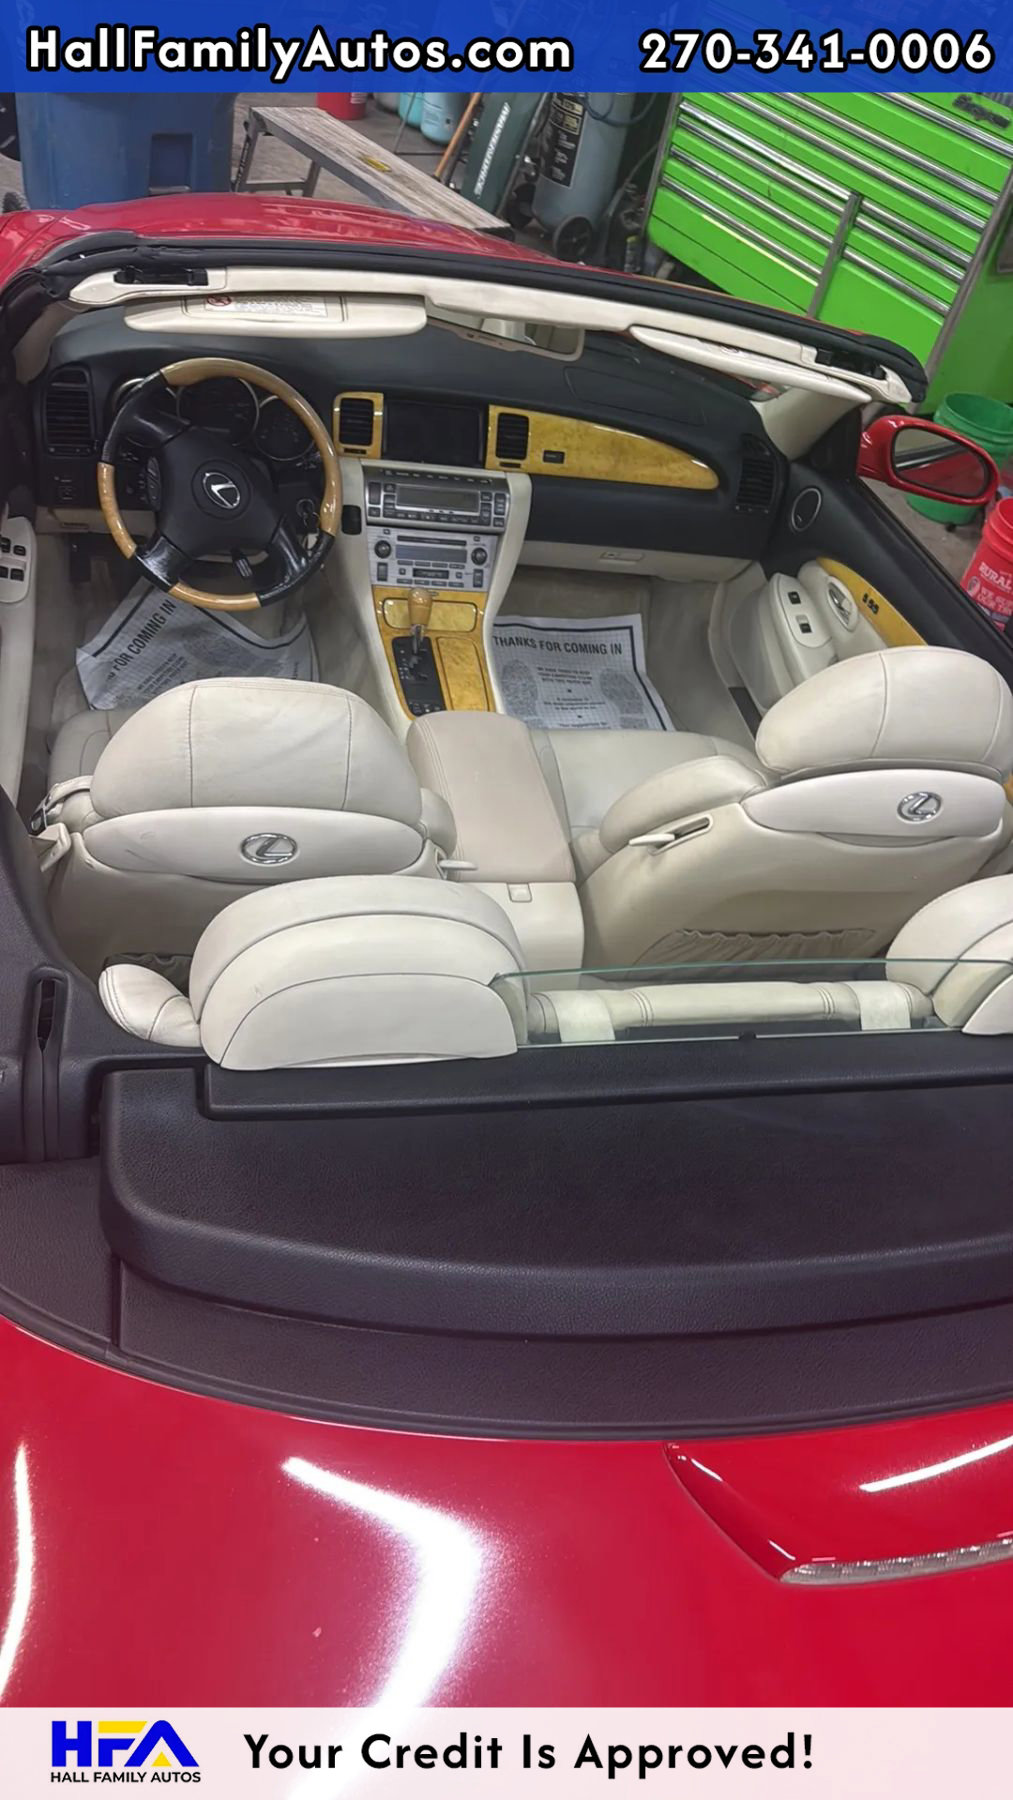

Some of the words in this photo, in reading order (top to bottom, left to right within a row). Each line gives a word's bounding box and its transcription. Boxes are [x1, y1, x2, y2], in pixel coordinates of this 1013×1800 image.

[127, 612, 167, 655] COMING
[159, 599, 177, 616] IN
[492, 635, 537, 649] THANKS
[540, 640, 561, 652] FOR
[564, 642, 607, 655] COMING
[610, 643, 622, 654] IN
